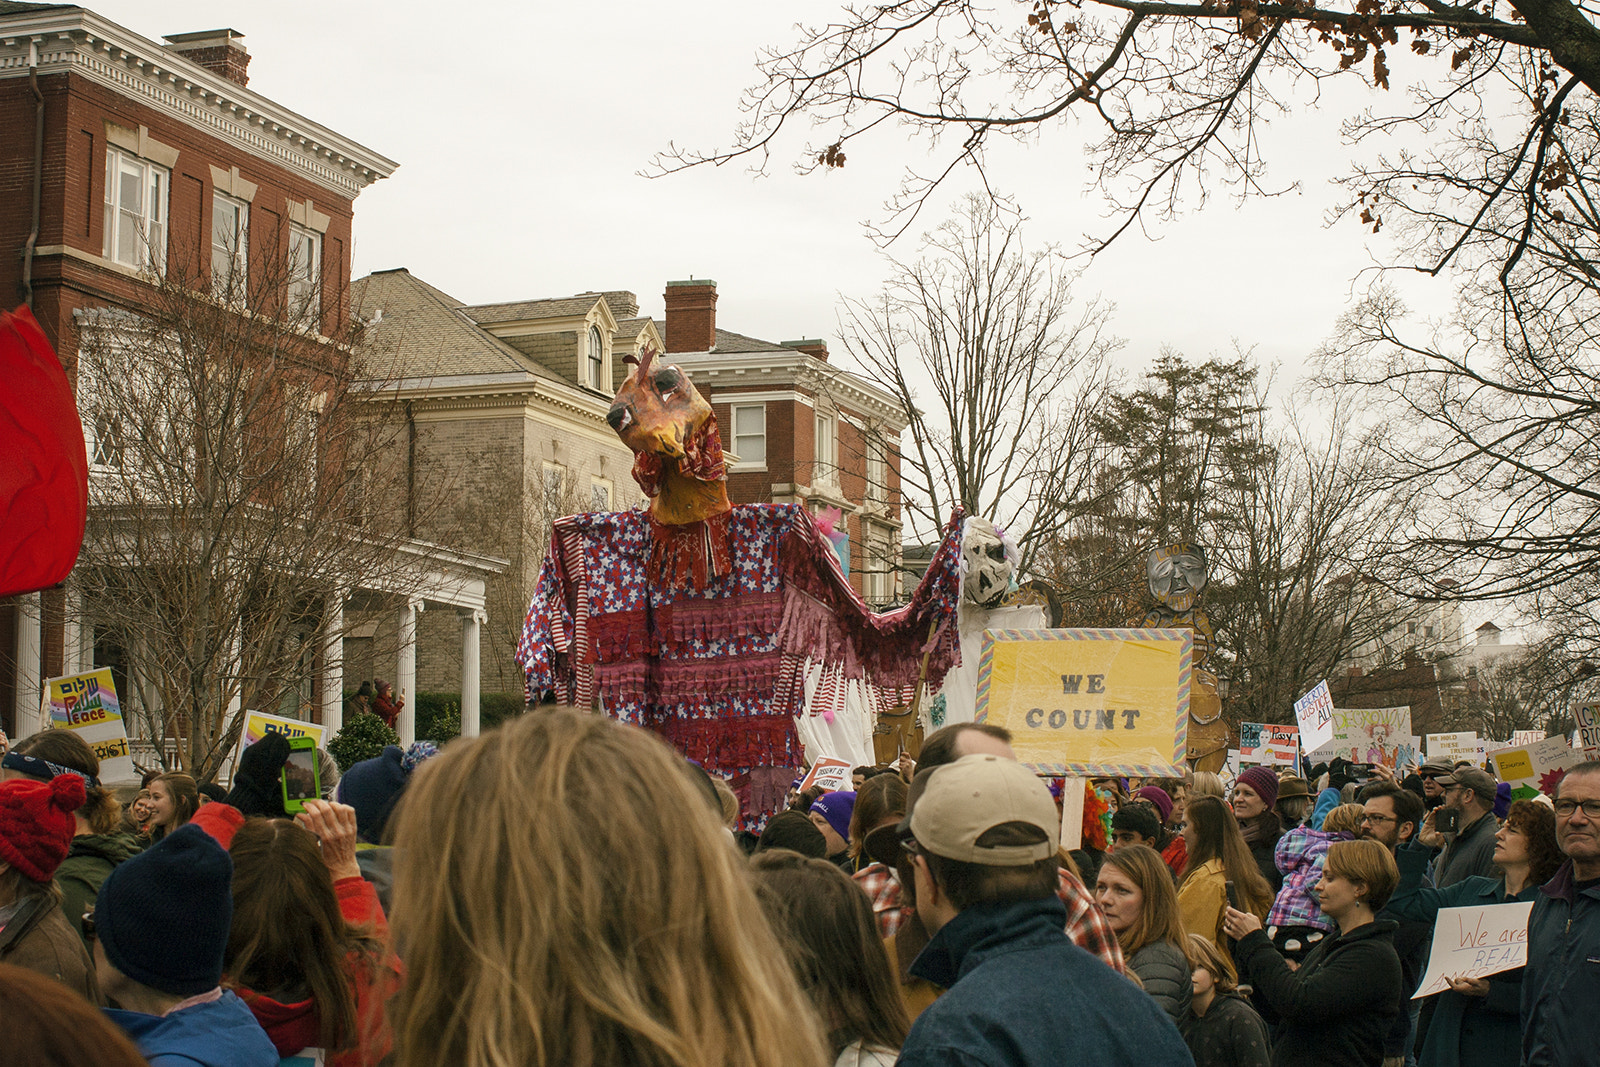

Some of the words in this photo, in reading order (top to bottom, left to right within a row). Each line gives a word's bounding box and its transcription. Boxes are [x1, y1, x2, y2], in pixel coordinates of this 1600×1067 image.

[1156, 543, 1190, 562] LOOK
[1000, 581, 1033, 606] LOOK
[1157, 585, 1197, 609] WITHIN
[60, 677, 99, 697] שלום
[1061, 674, 1106, 695] WE
[1296, 682, 1326, 712] LIBERTY
[1302, 691, 1330, 721] JUSTICE
[1025, 708, 1141, 730] COUNT
[1319, 705, 1333, 725] ALL
[1332, 709, 1407, 729] DECROWN
[1458, 911, 1488, 948] We
[1498, 929, 1527, 943] are
[1472, 946, 1521, 967] REAL
